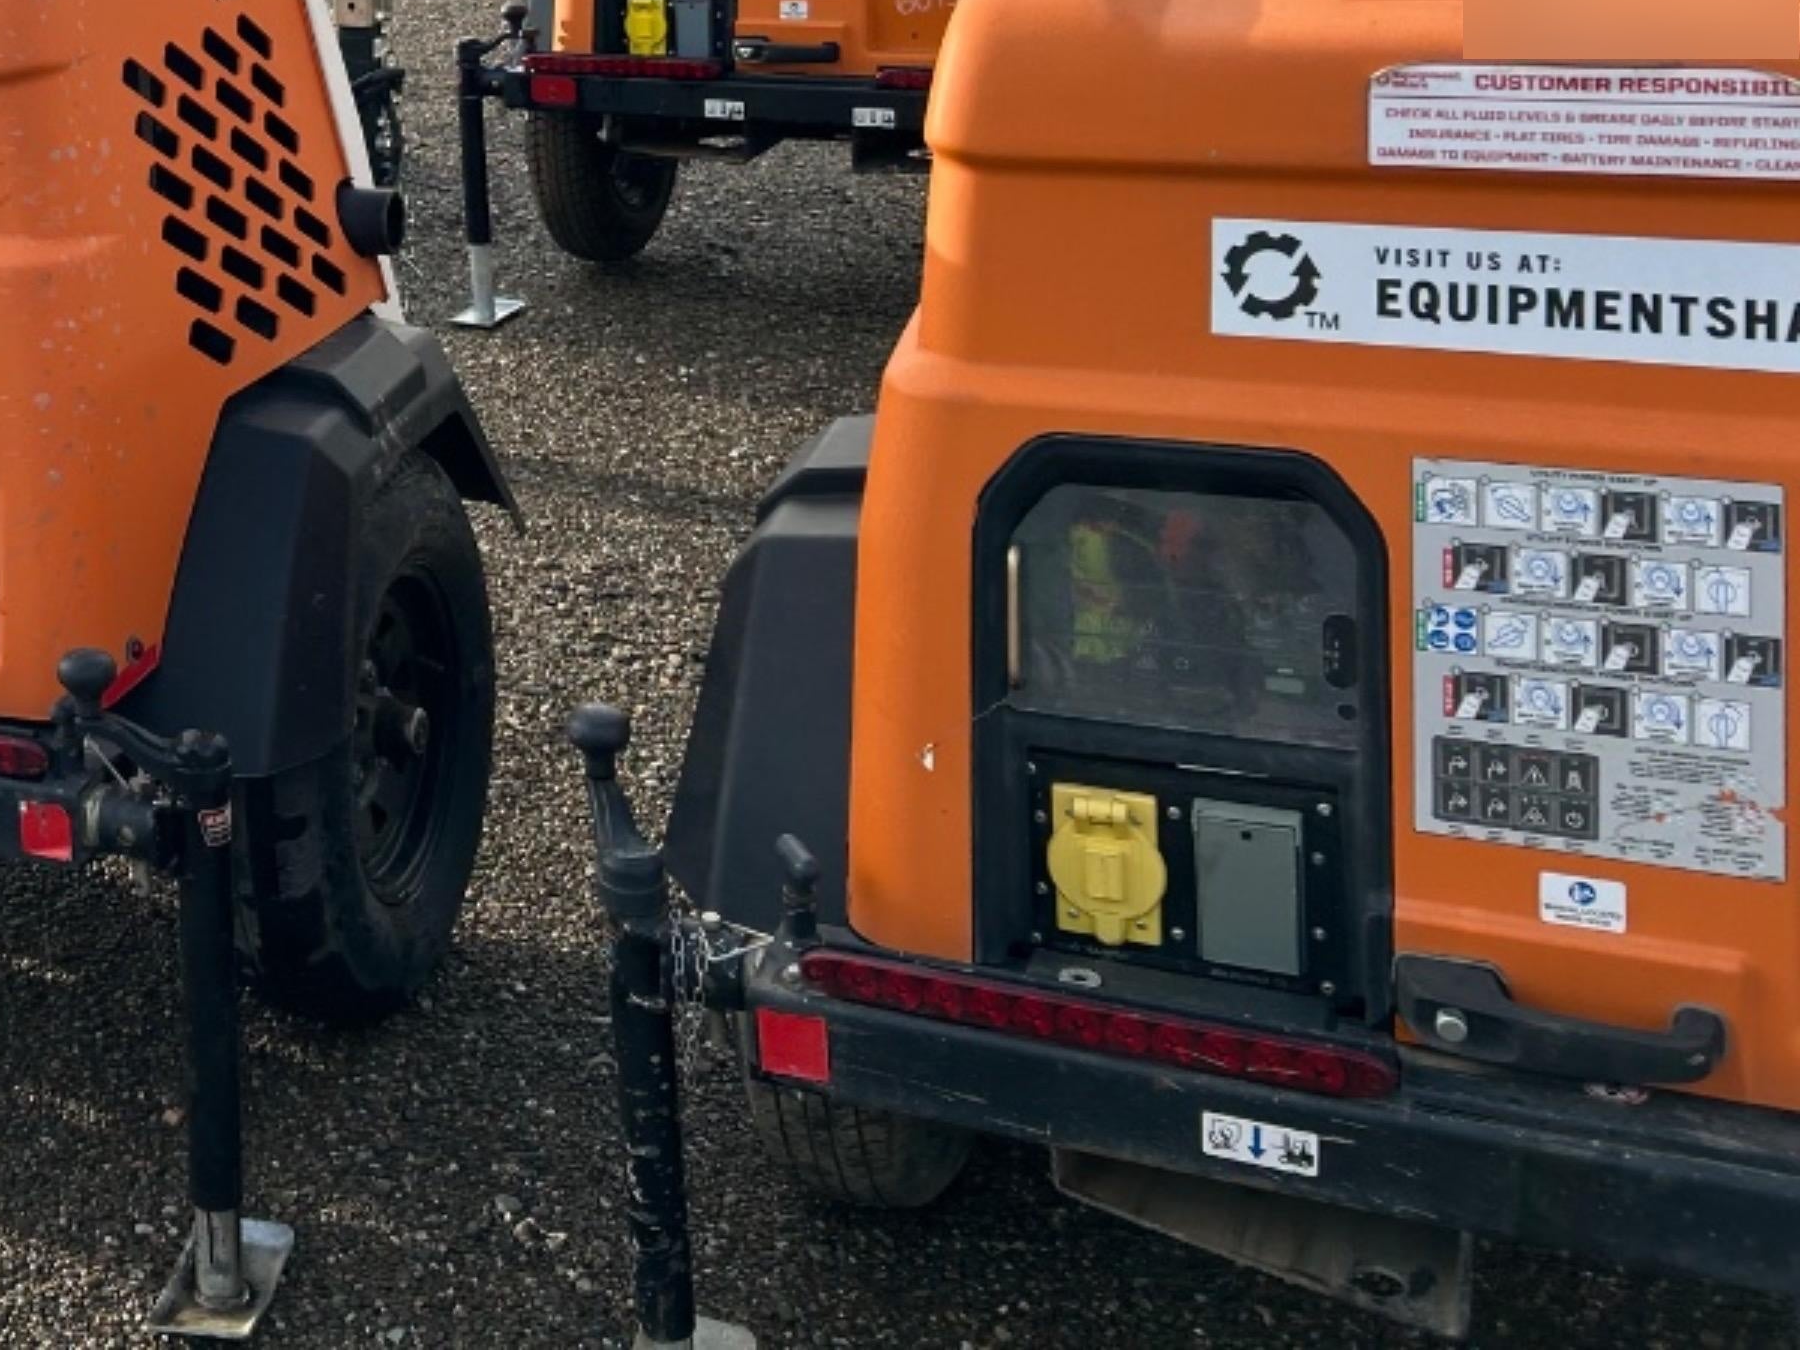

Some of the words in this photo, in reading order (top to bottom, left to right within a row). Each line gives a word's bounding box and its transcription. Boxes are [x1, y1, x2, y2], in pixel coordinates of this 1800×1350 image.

[1474, 74, 1611, 92] CUSTOMER
[1385, 107, 1431, 119] CHECK
[1435, 109, 1459, 121] ALL
[1463, 110, 1506, 121] FLUID
[1509, 111, 1561, 124] LEVELS
[1640, 114, 1684, 126] DAILY
[1688, 116, 1747, 128] BEFORE
[1408, 128, 1491, 141] INSURANCE
[1636, 135, 1701, 148] DAMAGE
[1377, 147, 1435, 159] DAMAGE
[1441, 150, 1459, 160] TO
[1463, 150, 1549, 163] EQUIPMENT
[1561, 152, 1626, 165] BATTERY
[1630, 155, 1741, 170] MAINTENANCE
[1374, 247, 1451, 269] VISIT
[1465, 251, 1502, 272] US
[1517, 253, 1563, 273] AT:
